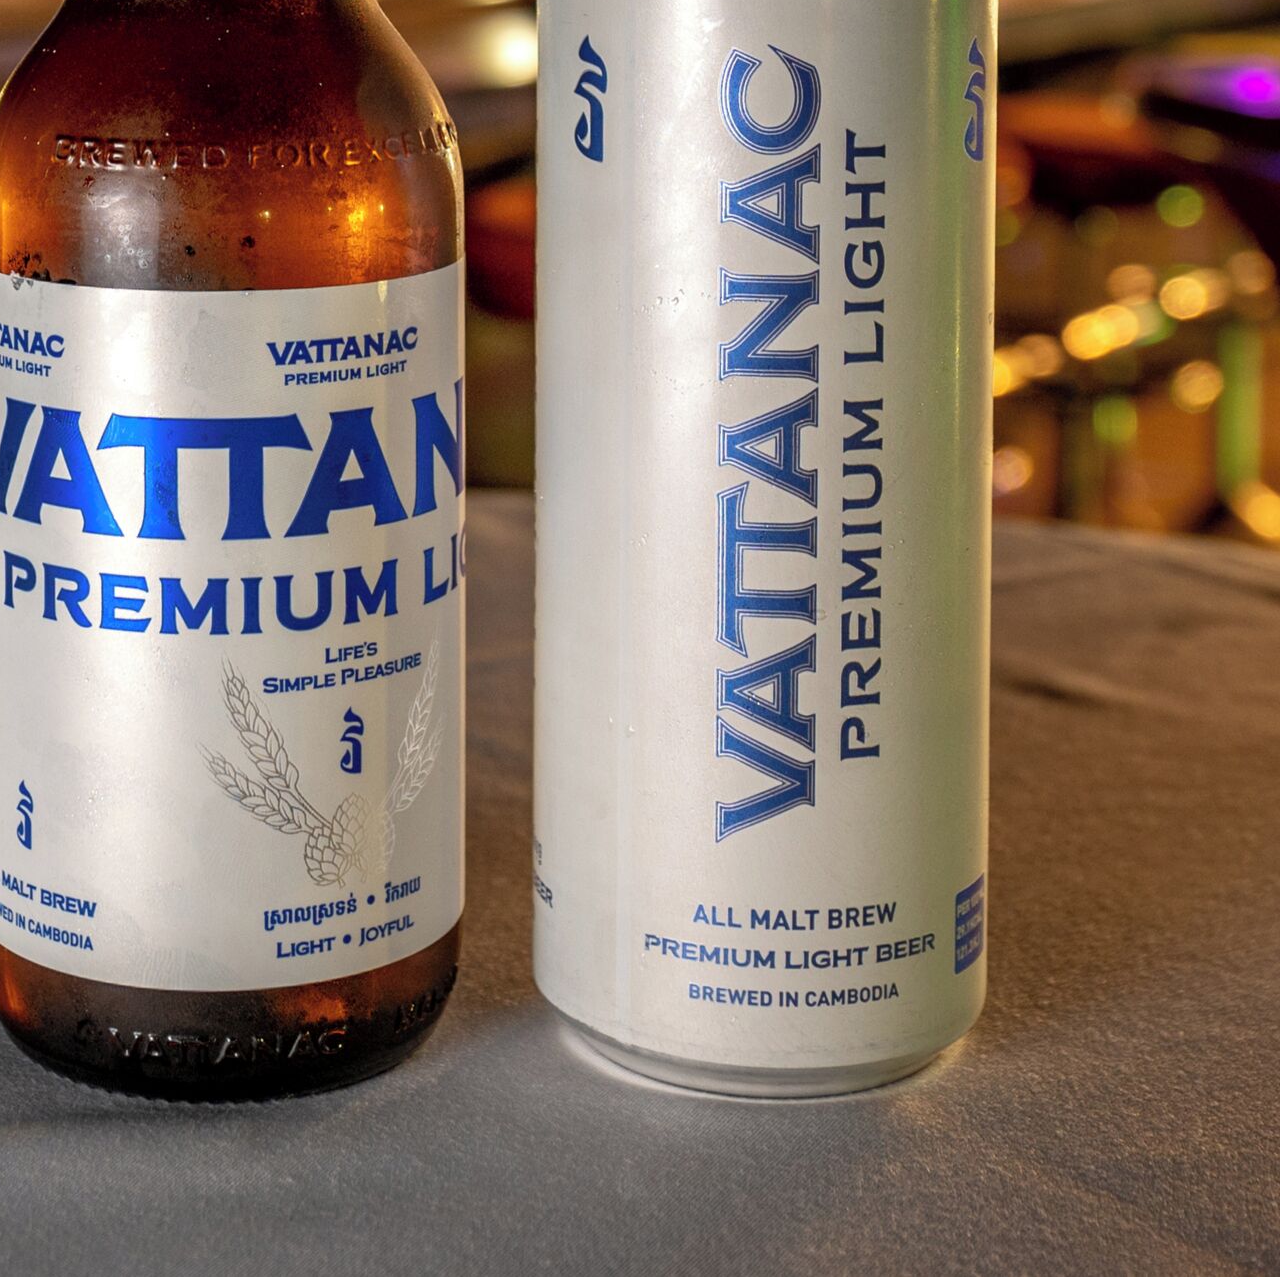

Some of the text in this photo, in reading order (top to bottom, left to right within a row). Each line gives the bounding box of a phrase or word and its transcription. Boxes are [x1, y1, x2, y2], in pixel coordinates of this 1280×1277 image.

[52, 134, 229, 170] BREWED
[266, 326, 418, 366] VATTANAC
[15, 359, 52, 377] LIGHT
[284, 360, 408, 386] PREMIUM LIGHT
[715, 44, 821, 844] VATTANAC
[841, 128, 887, 762] PREMIUM LIGHT
[3, 550, 399, 636] PREMIUM
[263, 652, 422, 694] SIMPLE PLEASURE
[325, 642, 378, 664] LIFE'S
[1, 869, 37, 901] MALT
[40, 888, 97, 919] BREW
[15, 912, 26, 931] IN
[28, 919, 95, 952] CAMBODIA
[693, 901, 897, 931] ALL MALT BREW
[276, 915, 415, 959] LIGHT JOYFUL
[645, 933, 776, 969] PREMIUM
[784, 946, 869, 970] LIGHT
[876, 933, 936, 964] BEER
[688, 982, 900, 1008] BREWED IN CAMBODIA
